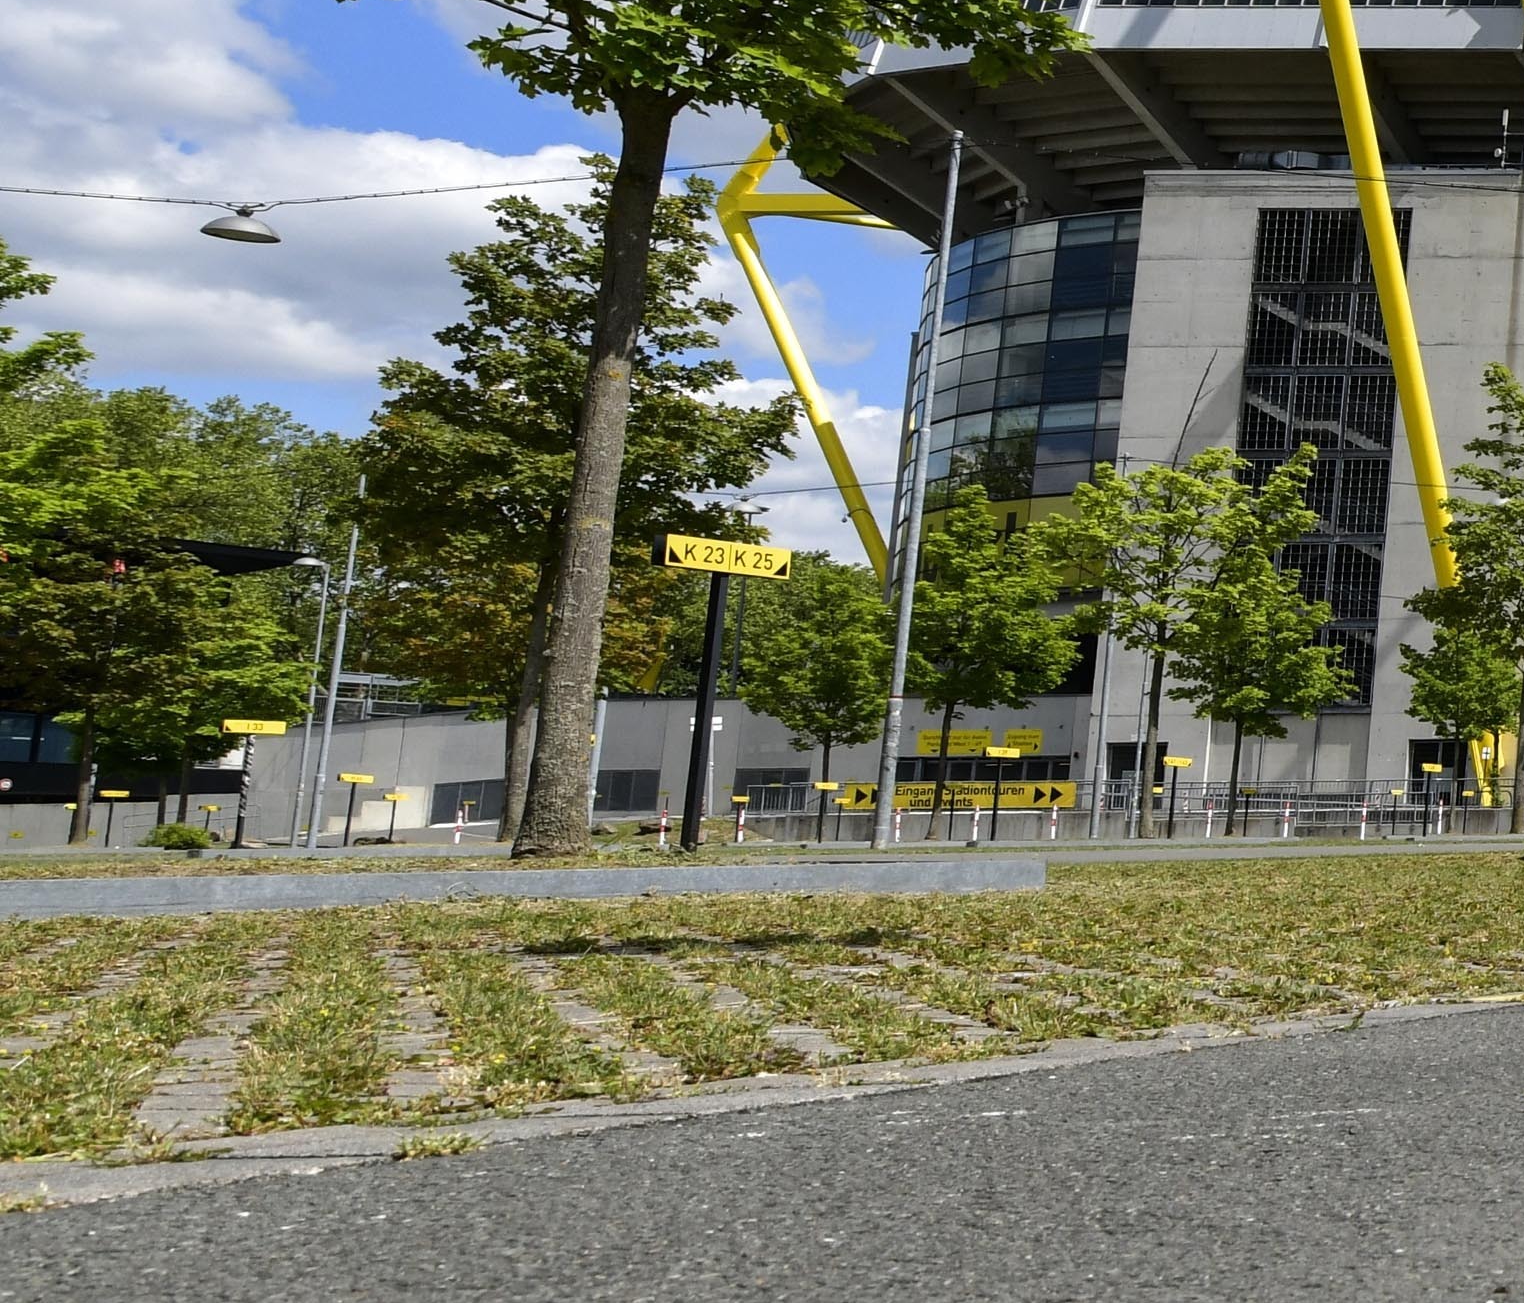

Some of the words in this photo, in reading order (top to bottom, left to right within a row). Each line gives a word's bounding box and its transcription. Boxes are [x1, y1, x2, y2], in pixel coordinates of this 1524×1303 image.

[684, 543, 697, 562] K
[703, 545, 725, 565] 23
[734, 549, 746, 568] K
[752, 552, 773, 570] 25
[895, 785, 934, 798] Eingan
[944, 785, 1024, 796] Sadiontouren
[909, 797, 931, 807] und
[941, 797, 973, 807] vnts
